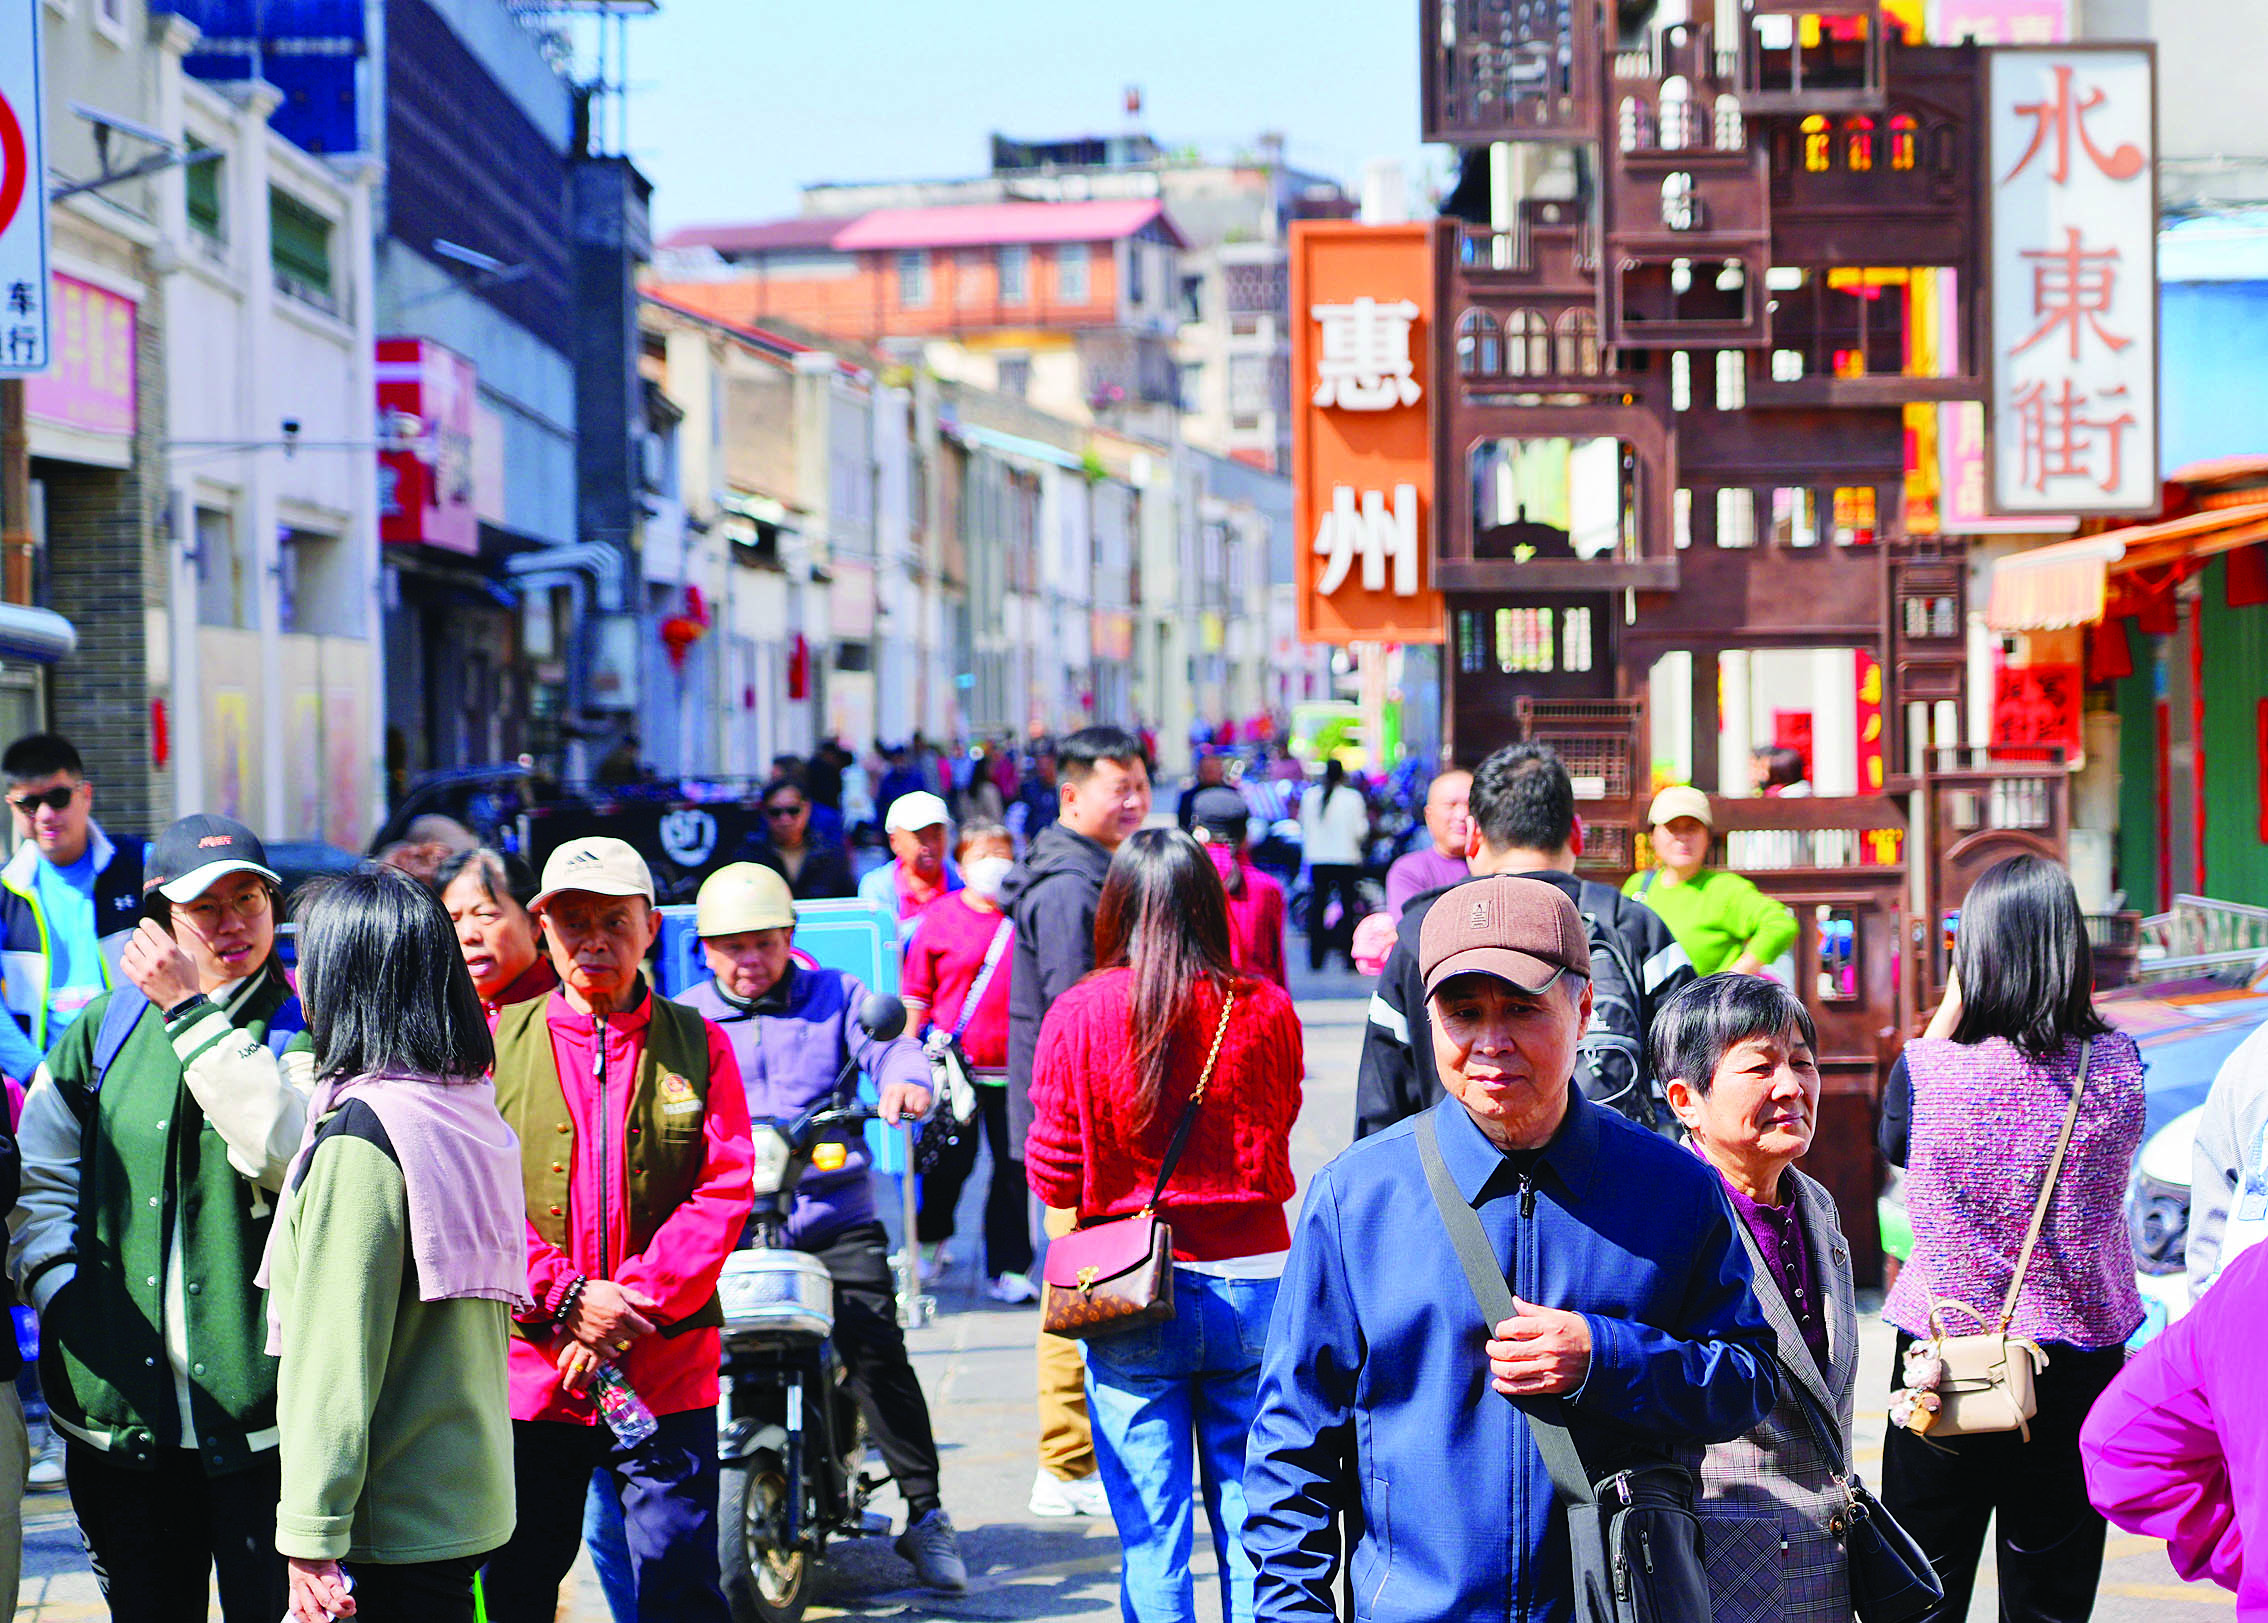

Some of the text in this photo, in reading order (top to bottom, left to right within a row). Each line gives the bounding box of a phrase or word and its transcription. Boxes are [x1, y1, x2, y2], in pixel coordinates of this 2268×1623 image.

[1311, 296, 1421, 596] 惠州
[2001, 64, 2145, 493] 水東街
